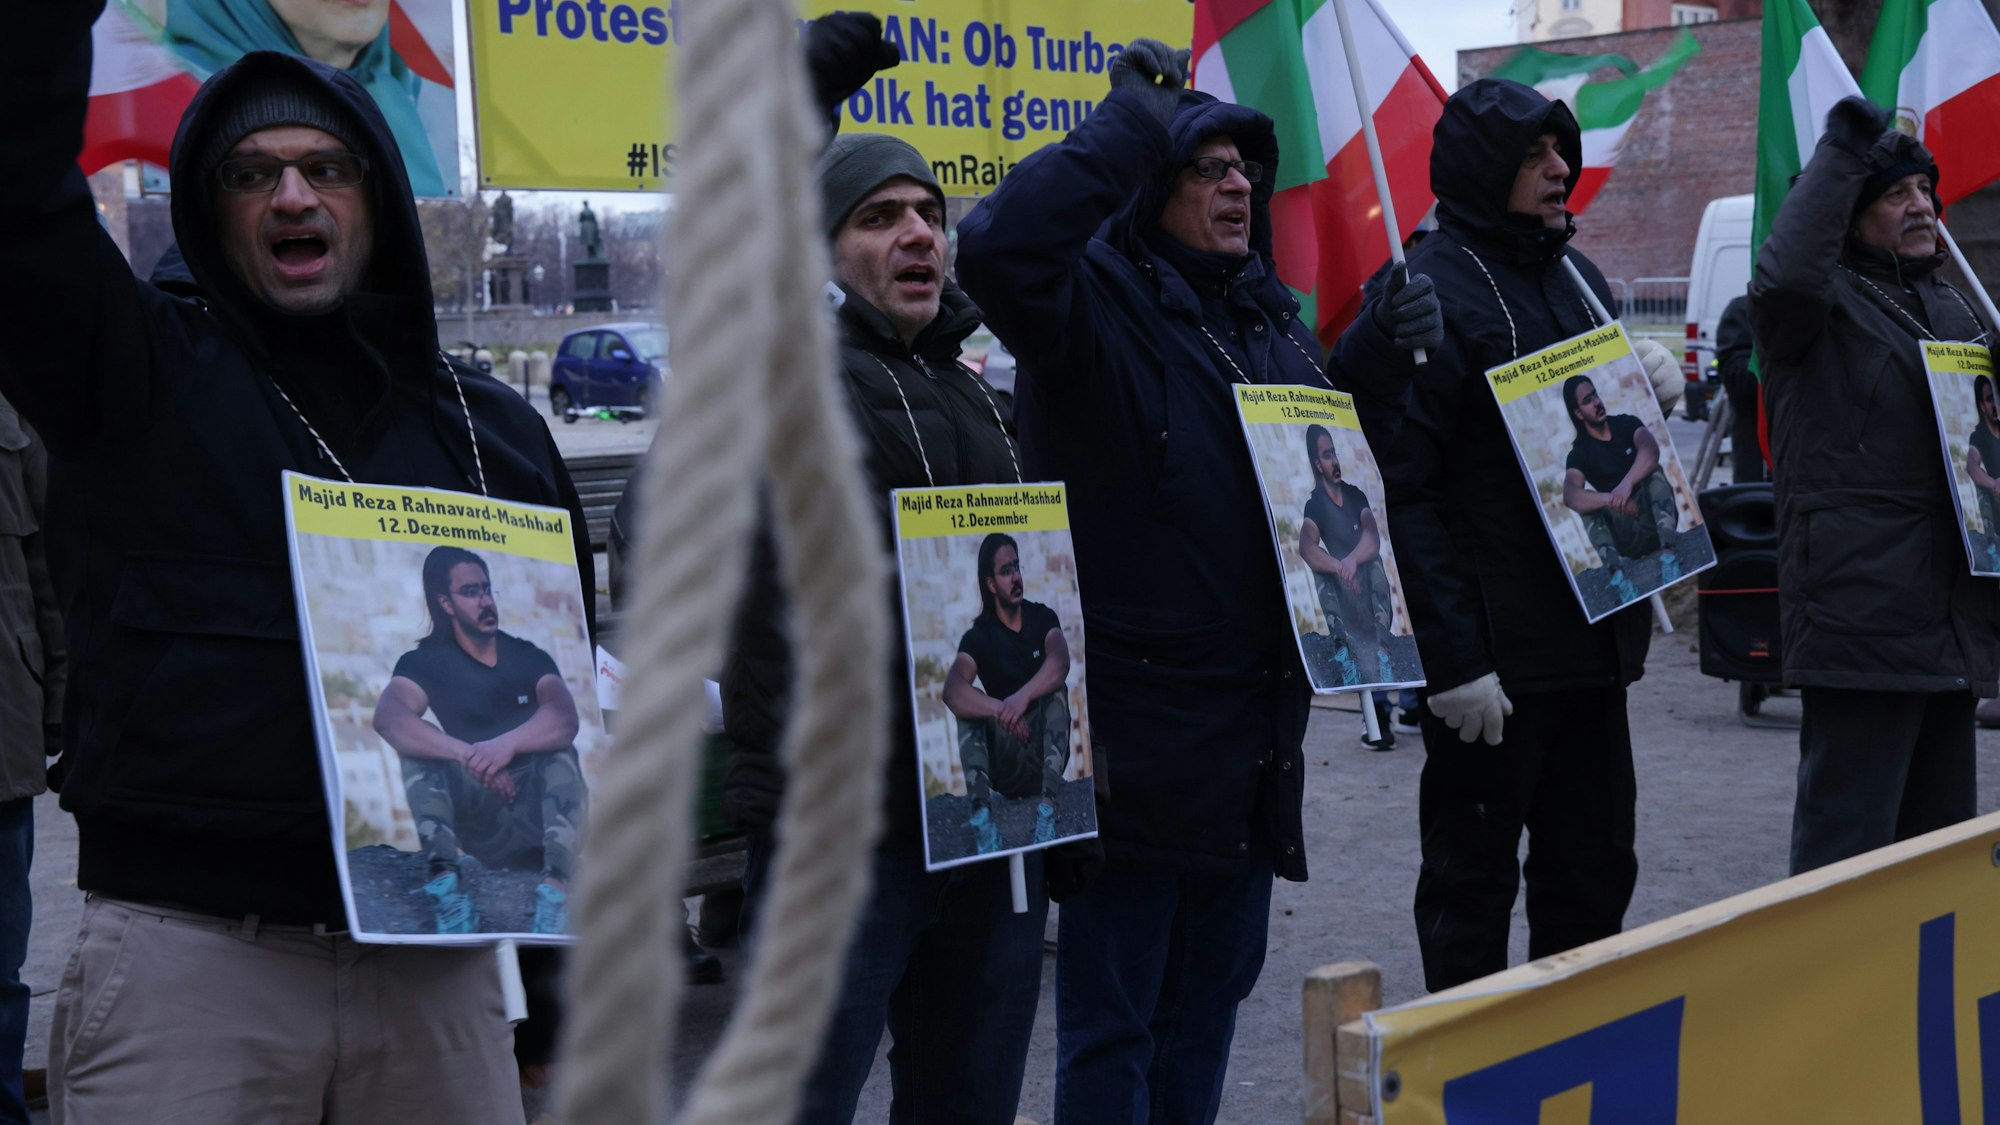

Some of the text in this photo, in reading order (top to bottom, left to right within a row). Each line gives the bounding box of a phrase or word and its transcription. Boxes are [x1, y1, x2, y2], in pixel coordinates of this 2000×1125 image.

[963, 21, 1017, 69] Ob
[1026, 25, 1126, 75] Turba
[833, 77, 1093, 140] olk hat genu
[1493, 367, 1519, 386] Majid
[1519, 361, 1542, 374] Reza
[1241, 389, 1266, 405] Majid
[1266, 390, 1288, 402] Reza
[298, 483, 564, 535] Majid Reza Rahnavard-Mashhad
[902, 490, 1062, 515] Majid Reza Rahnavard-Mashhad
[377, 516, 507, 545] 12.Dezemmber
[951, 511, 1029, 529] 12.Dezemmber
